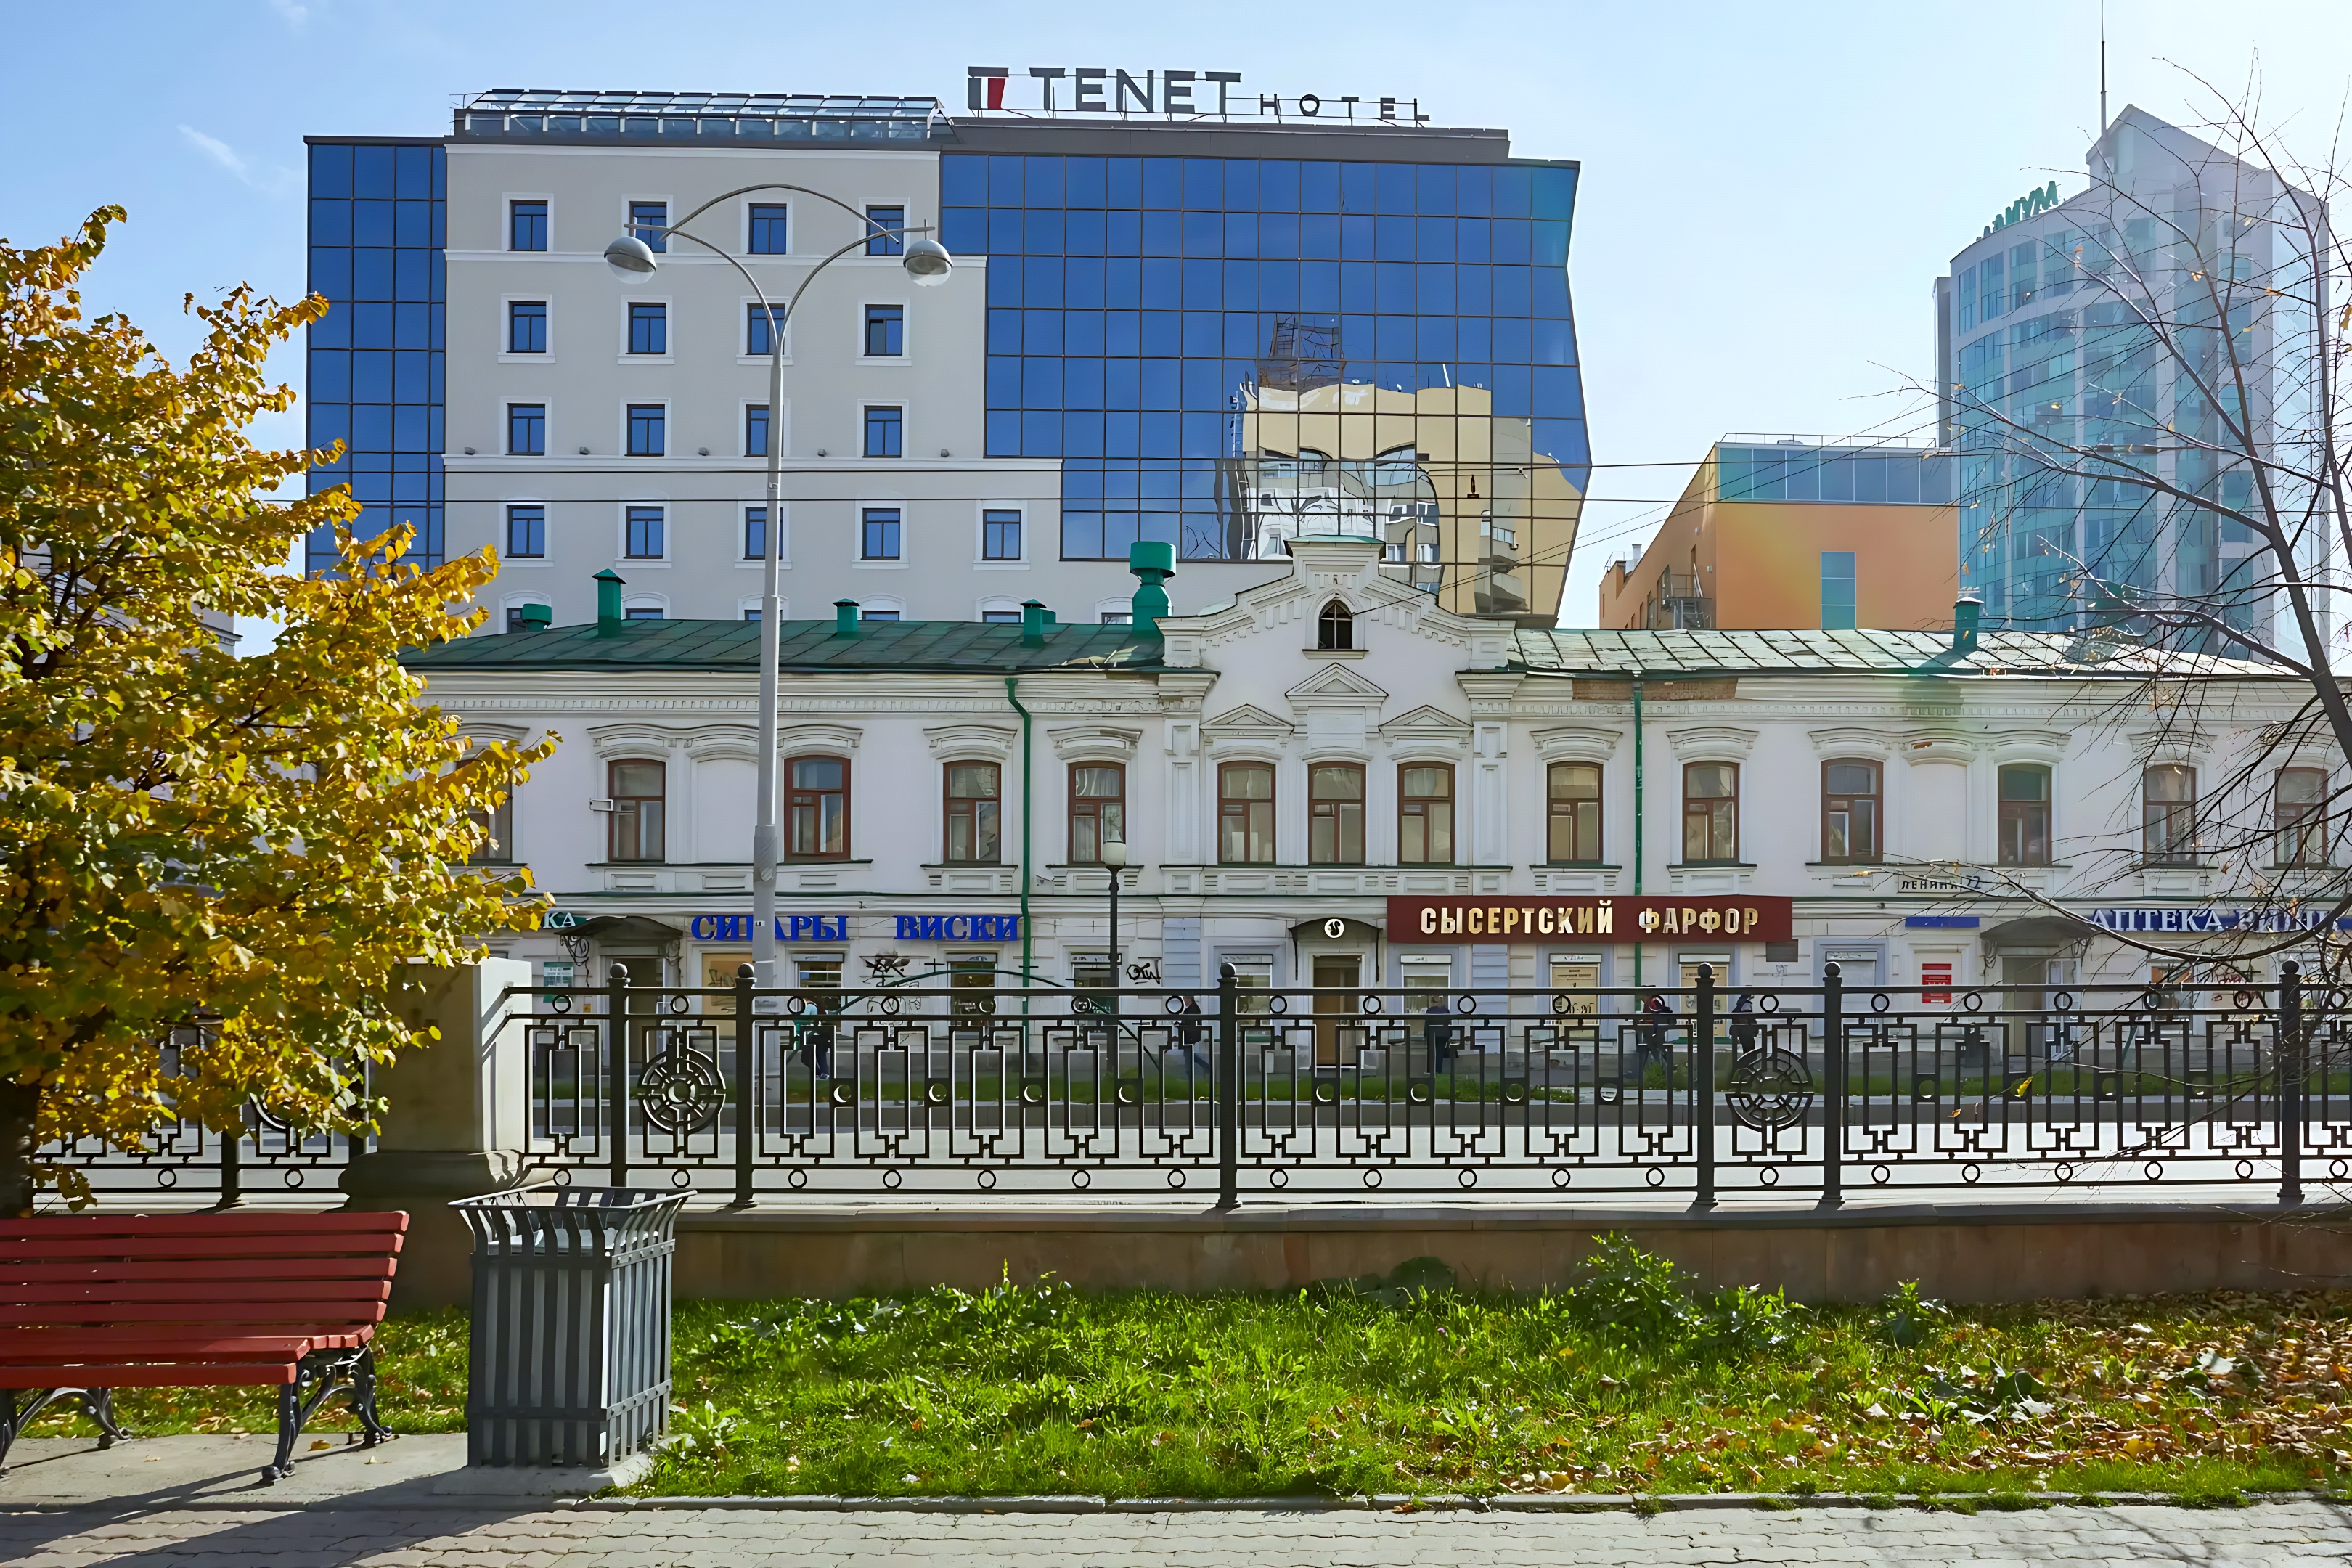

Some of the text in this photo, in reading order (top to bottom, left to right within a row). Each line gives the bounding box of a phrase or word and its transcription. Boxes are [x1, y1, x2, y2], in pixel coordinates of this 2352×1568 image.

[1029, 66, 1431, 121] TENET HOTEL
[894, 915, 1021, 942] ВИСКИ
[1421, 899, 1759, 934] СЫСЕРТСКИЙ ФАРФОР
[2093, 909, 2224, 933] АПТЕКА
